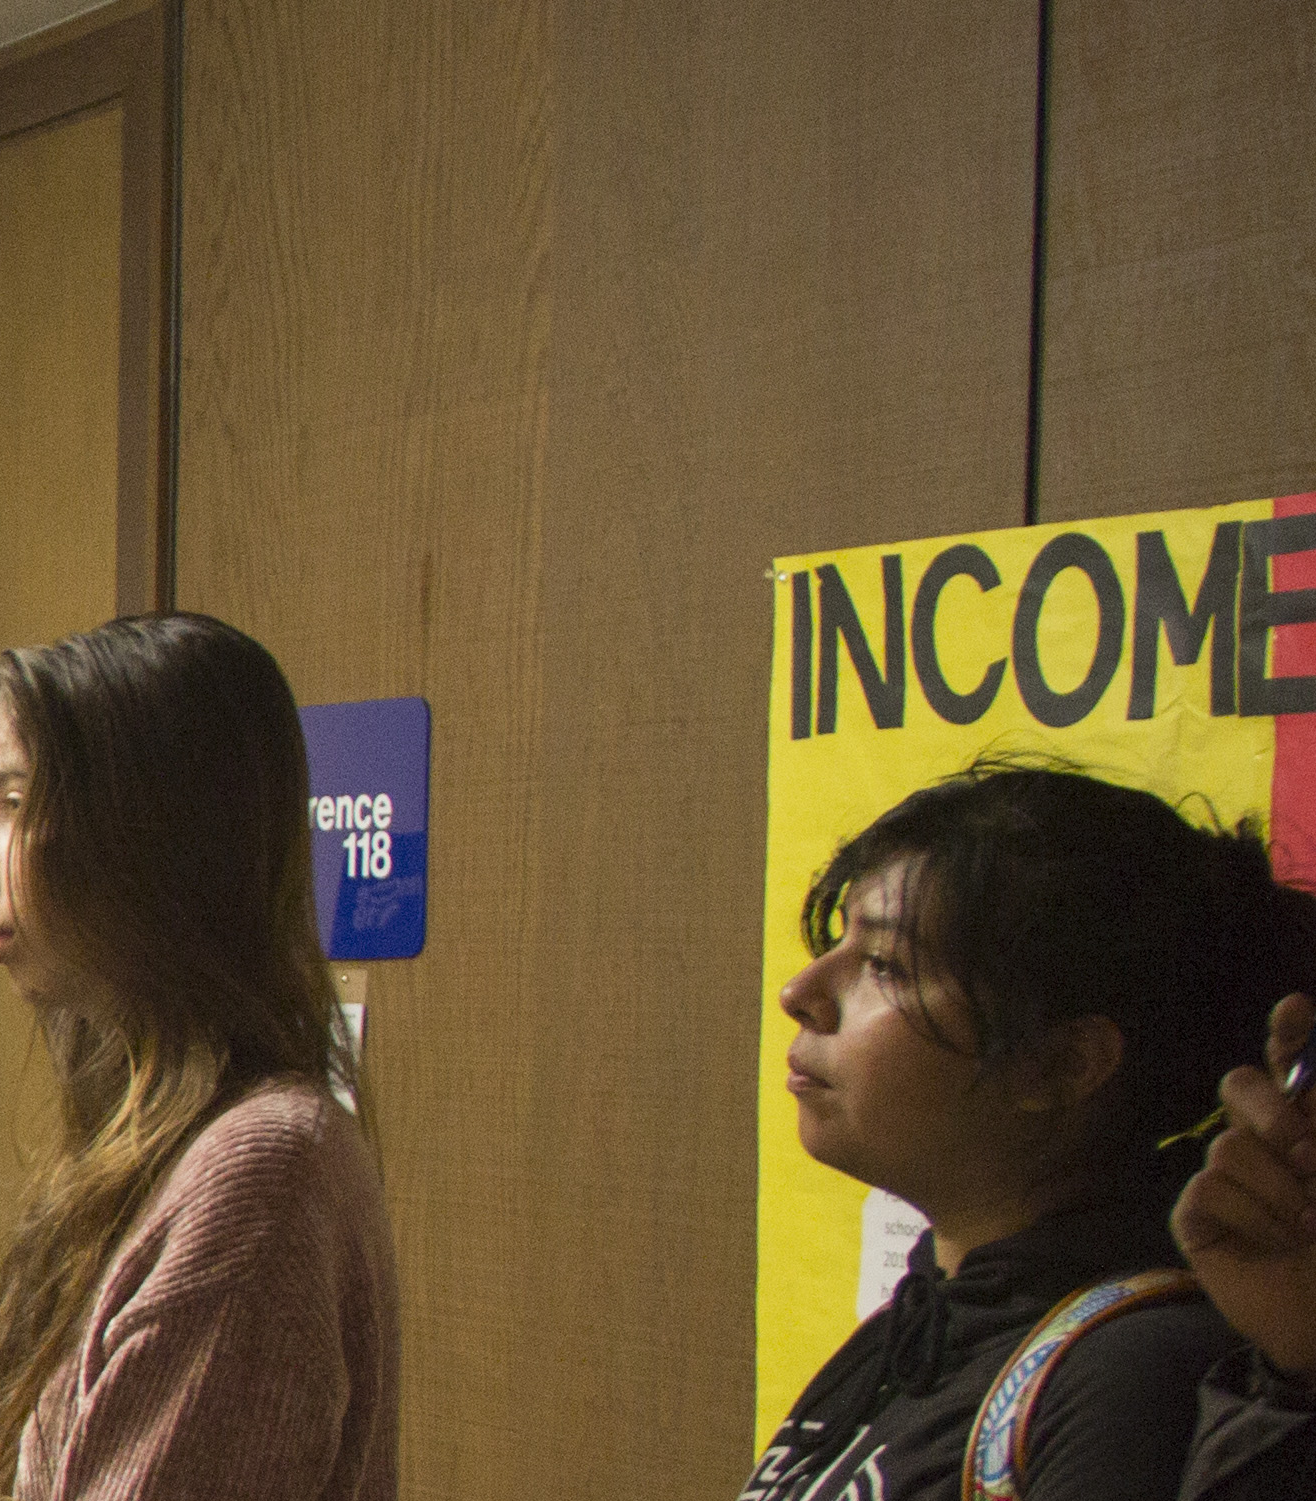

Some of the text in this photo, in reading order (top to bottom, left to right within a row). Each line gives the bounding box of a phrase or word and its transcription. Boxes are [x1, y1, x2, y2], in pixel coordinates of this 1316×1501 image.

[791, 511, 1315, 740] INCOME
[308, 793, 392, 832] rence
[342, 830, 392, 879] 118
